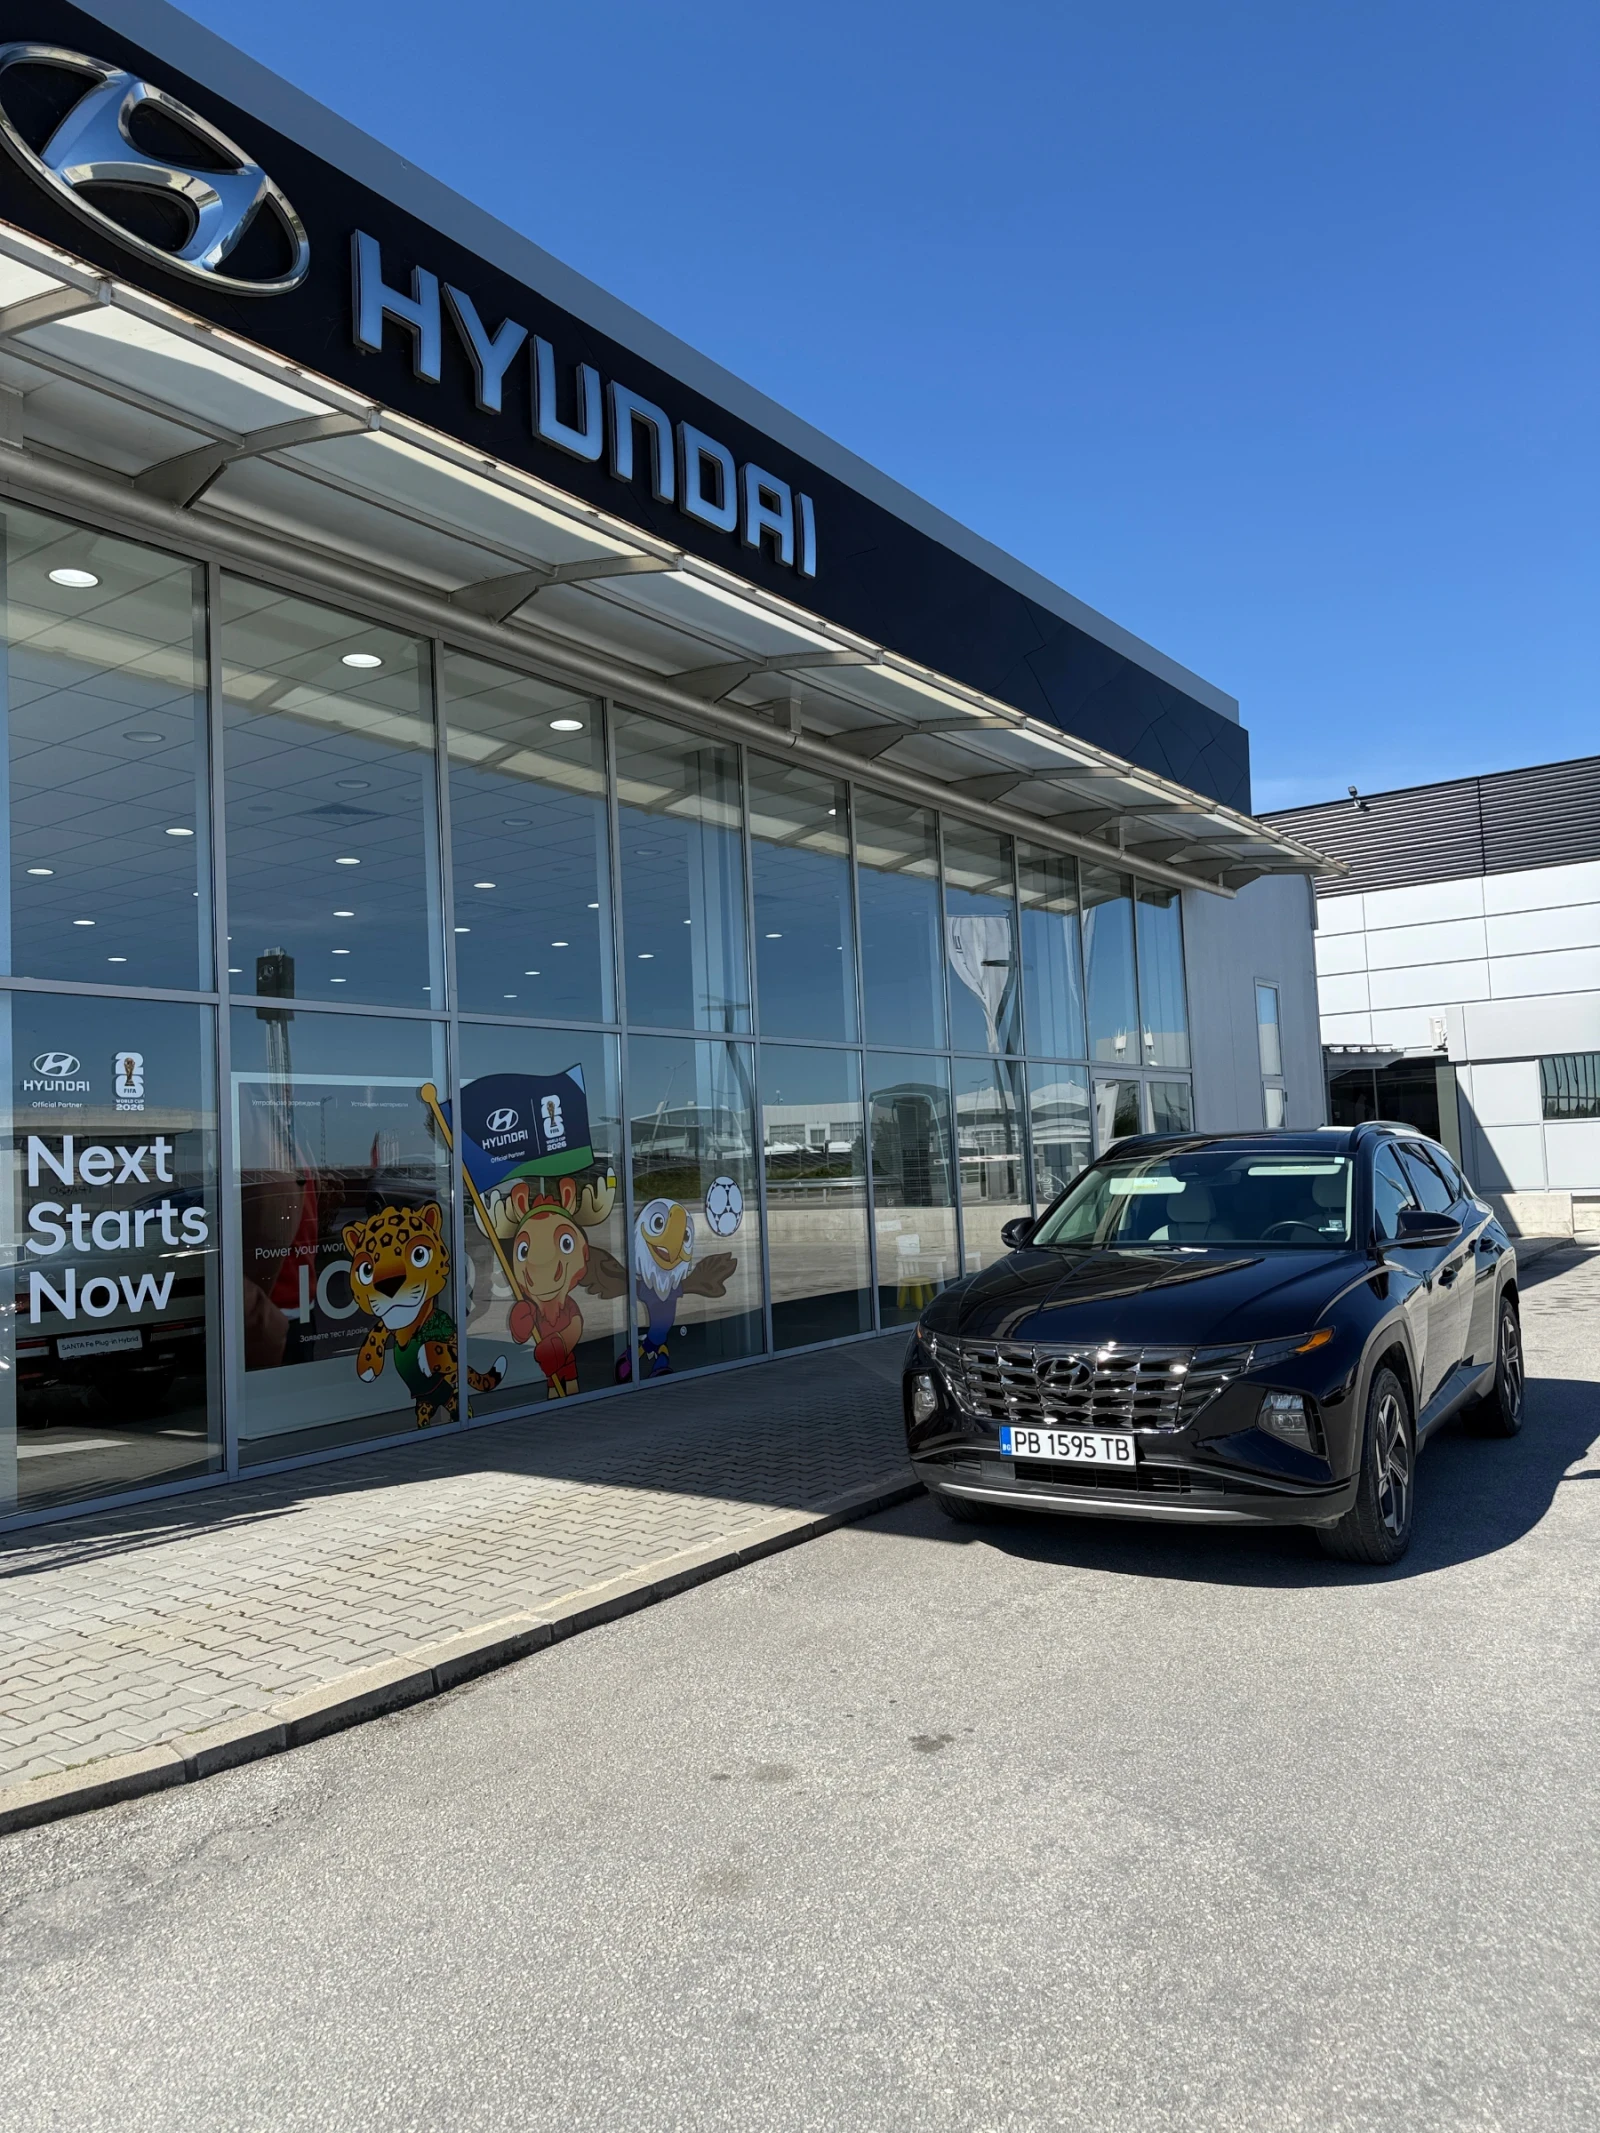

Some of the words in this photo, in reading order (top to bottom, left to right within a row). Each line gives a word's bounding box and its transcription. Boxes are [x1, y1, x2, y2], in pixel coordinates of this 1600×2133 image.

[351, 229, 817, 578] HYUNDAI
[23, 1080, 90, 1091] HYUNDAI
[482, 1129, 528, 1150] HYUNDAI
[547, 1141, 567, 1151] 2026
[27, 1135, 173, 1187] Next
[490, 1154, 508, 1163] Official
[508, 1150, 525, 1159] Partner
[25, 1200, 209, 1255] Starts
[255, 1247, 292, 1260] Power
[295, 1245, 320, 1258] your
[29, 1268, 176, 1324] Now
[61, 1342, 85, 1351] SANTA
[95, 1338, 118, 1347] Plug-in
[118, 1335, 139, 1344] Hybrid
[299, 1332, 329, 1343] Заявете
[330, 1330, 345, 1338] тест
[1014, 1430, 1041, 1454] PB
[1047, 1433, 1097, 1459] 1595
[1101, 1437, 1130, 1461] TB
